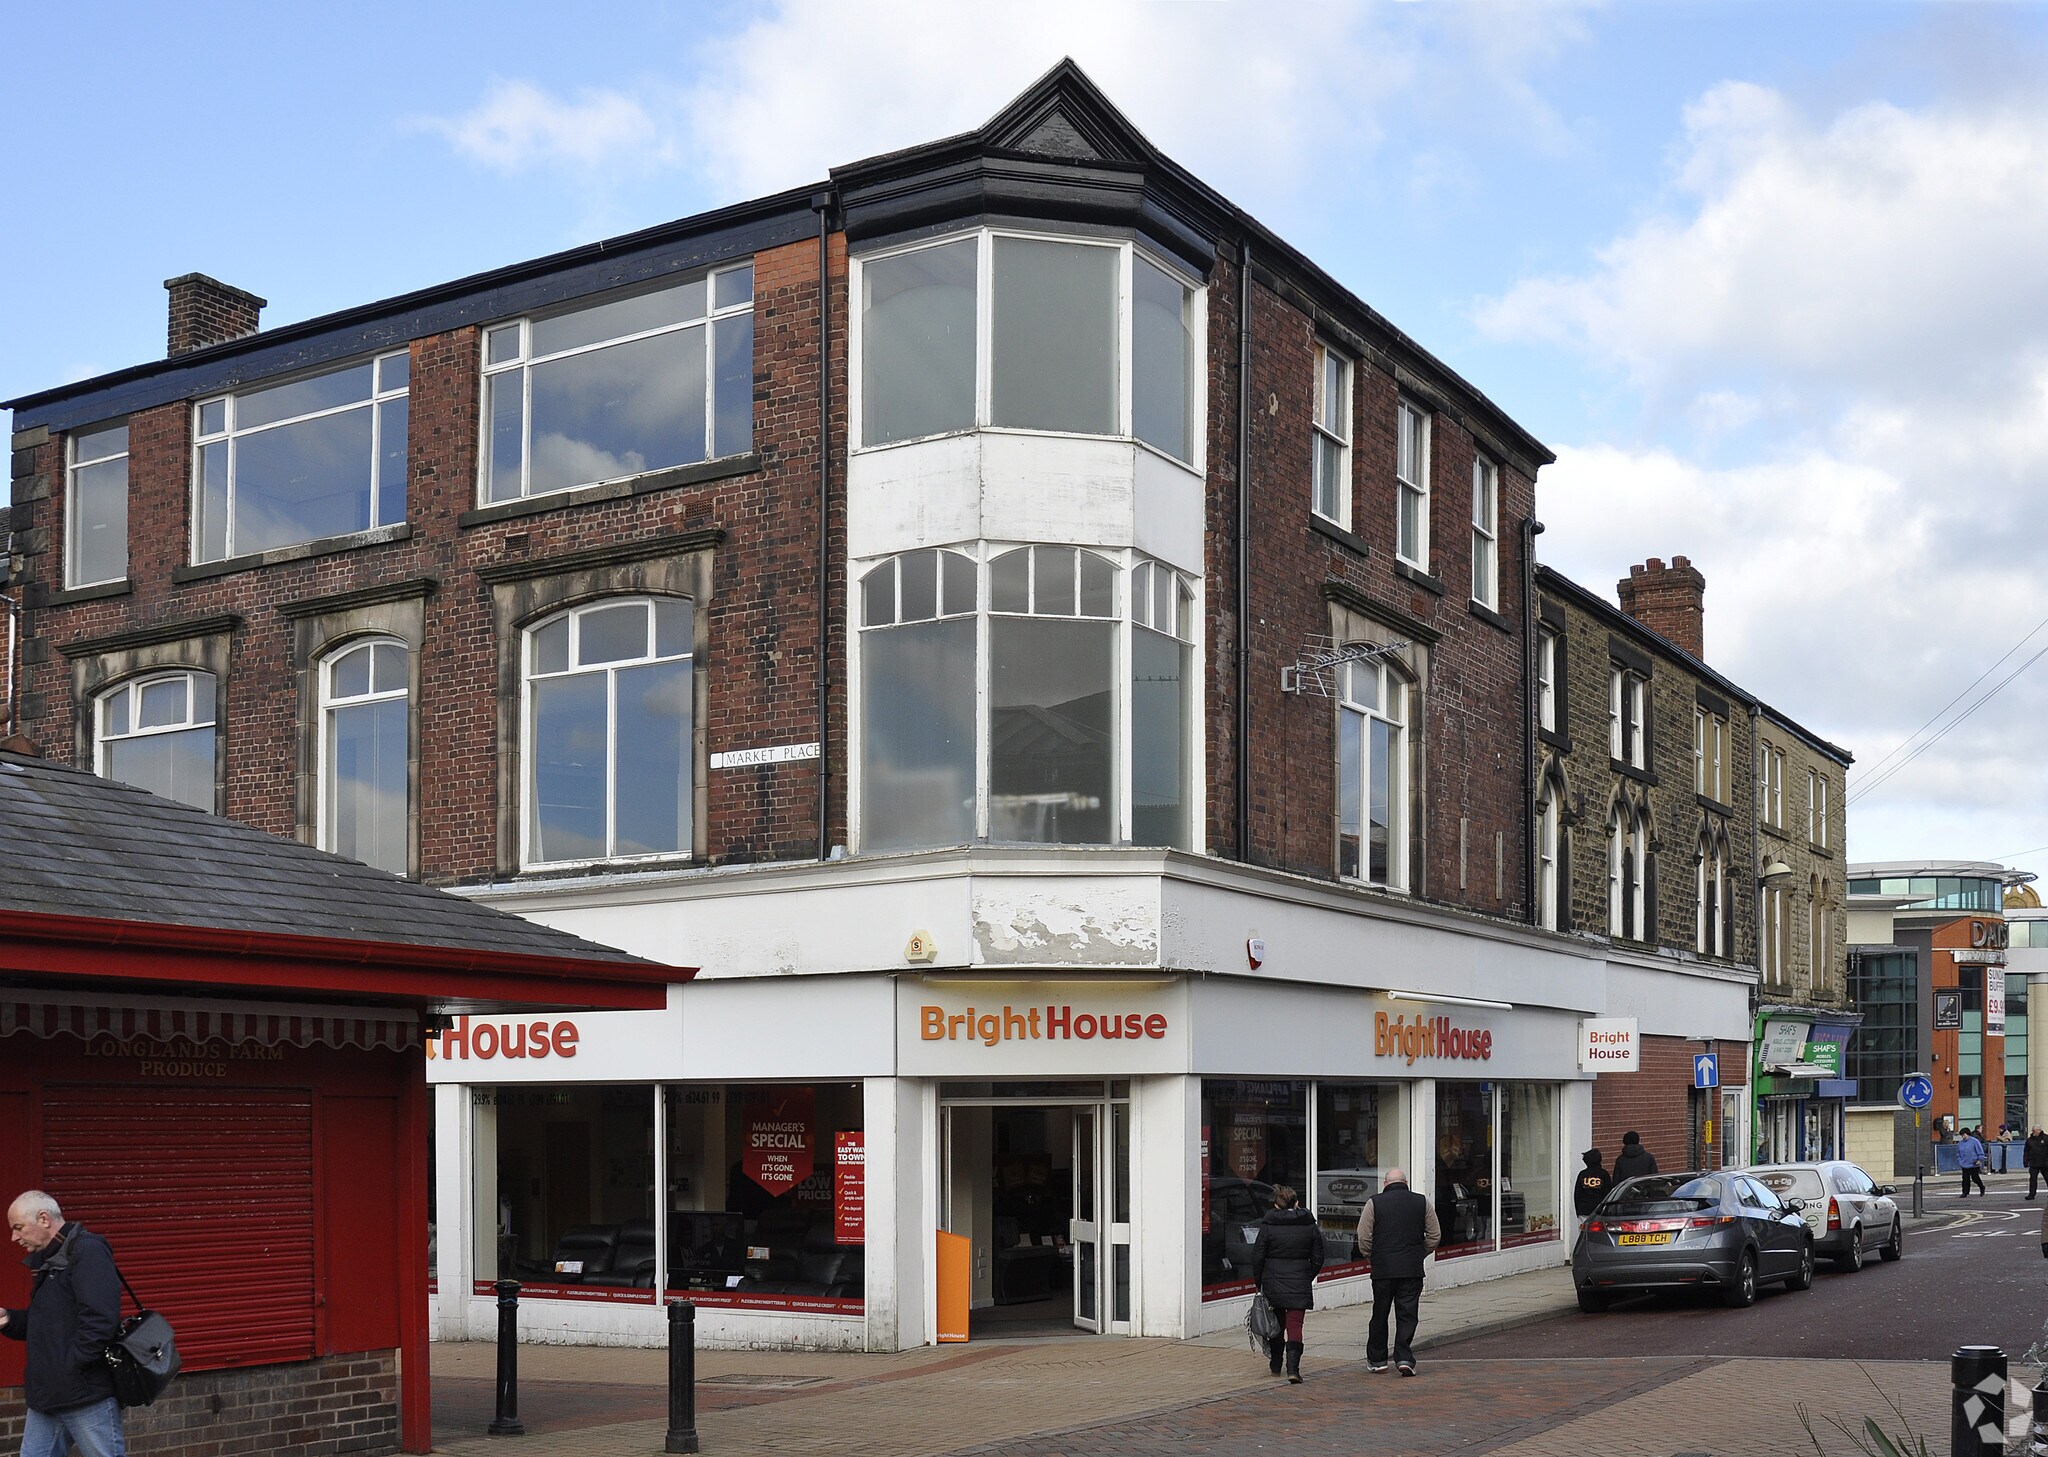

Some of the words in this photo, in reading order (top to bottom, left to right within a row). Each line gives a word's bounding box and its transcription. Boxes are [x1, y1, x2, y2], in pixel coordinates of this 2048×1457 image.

[726, 749, 776, 765] MARKET
[784, 745, 821, 760] PLACE
[443, 1015, 580, 1060] House
[1590, 1031, 1630, 1045] Bright
[84, 1041, 220, 1059] LONGLANDS
[229, 1045, 284, 1060] FARM
[1589, 1048, 1631, 1059] House
[139, 1061, 228, 1076] PRODUCE
[752, 1122, 805, 1133] MANAGER'S
[1233, 1127, 1262, 1141] SPECIAL
[751, 1133, 806, 1149] SPECIAL
[767, 1154, 788, 1163] WHEN
[761, 1164, 773, 1172] IT'S
[773, 1164, 795, 1173] GONE,
[761, 1173, 773, 1181] IT'S
[773, 1173, 793, 1181] GONE
[798, 1176, 832, 1190] LOW
[1583, 1177, 1602, 1187] UGG
[798, 1190, 833, 1201] PRICES
[1622, 1234, 1646, 1244] L888
[1649, 1233, 1668, 1243] TCH
